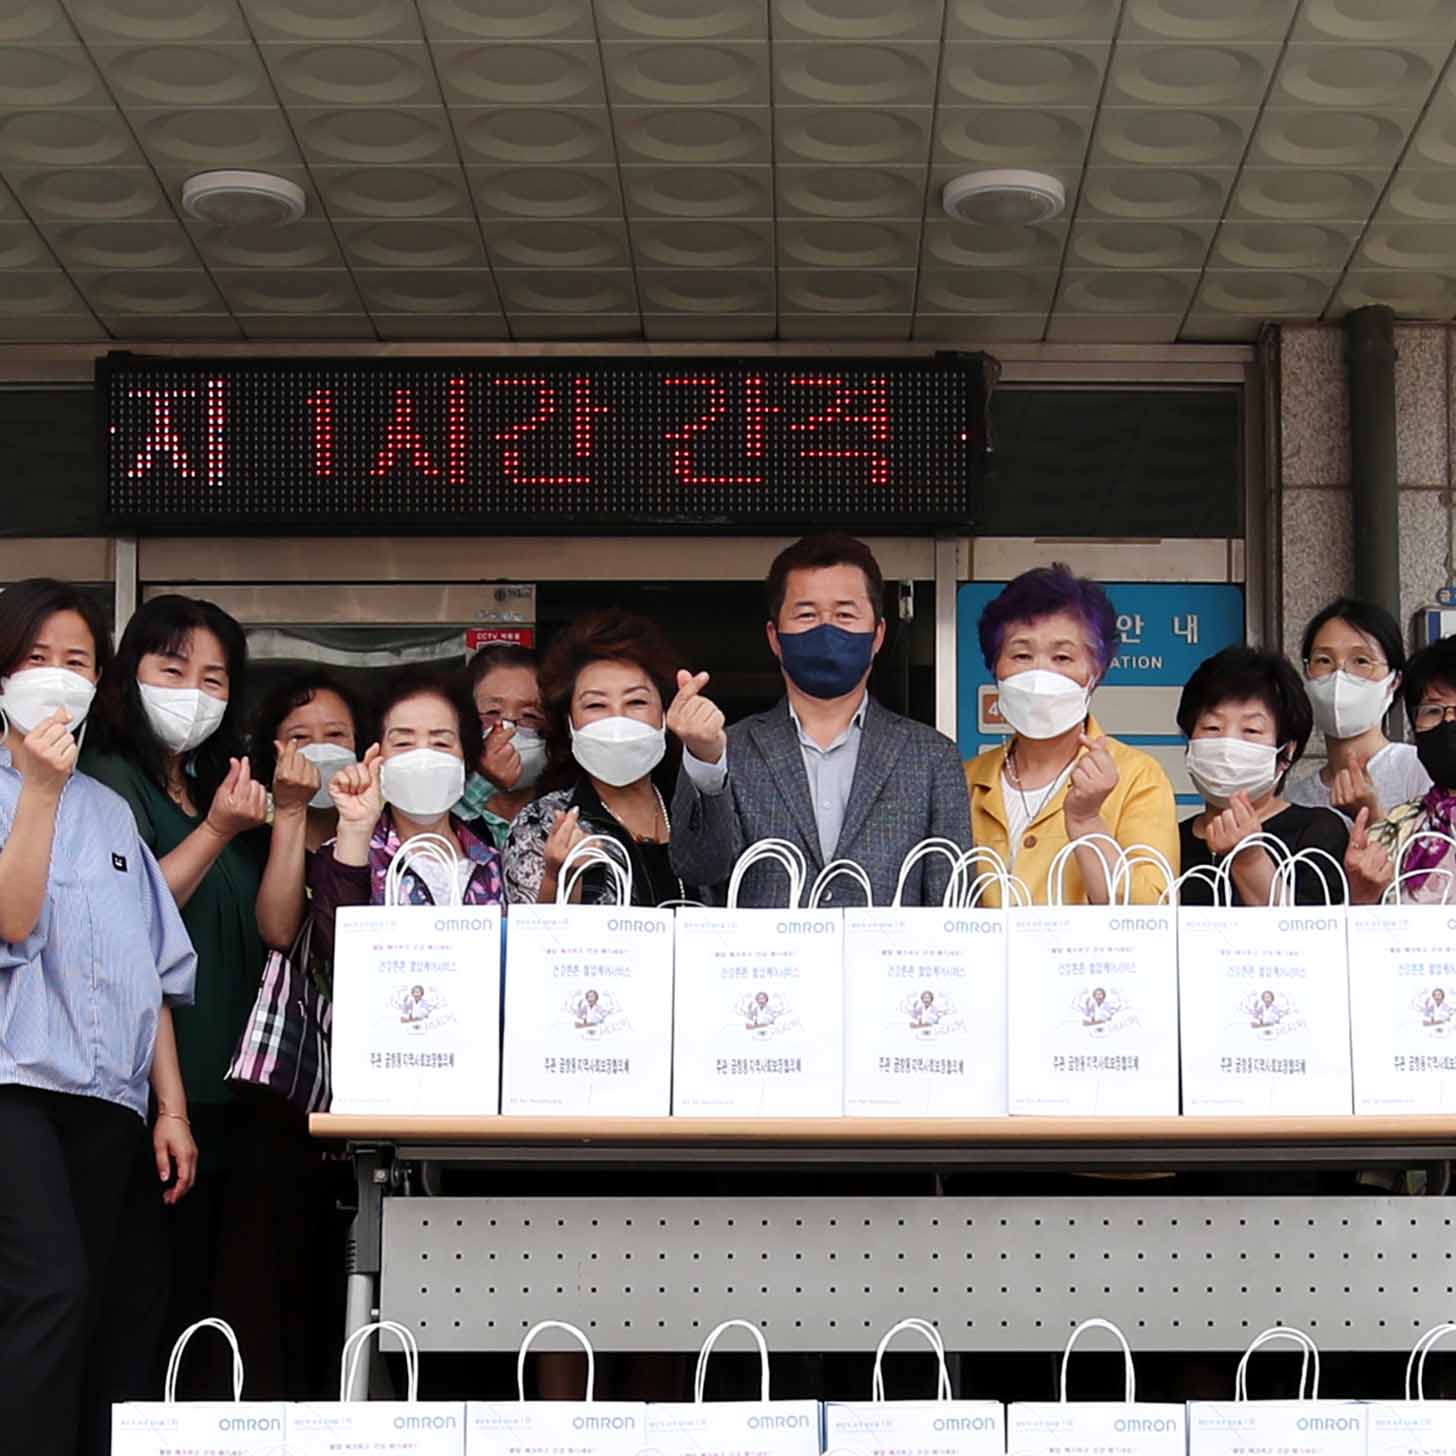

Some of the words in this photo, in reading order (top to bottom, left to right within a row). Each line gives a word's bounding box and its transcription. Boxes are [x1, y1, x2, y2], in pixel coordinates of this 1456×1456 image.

[663, 378, 891, 486] 간격
[434, 918, 492, 931] OMRON
[607, 919, 666, 933] OMRON
[776, 921, 835, 934] OMRON
[944, 920, 1002, 933] OMRON
[1109, 918, 1168, 931] OMRON
[1278, 919, 1338, 932] OMRON
[219, 1418, 280, 1431] OMRON
[393, 1416, 456, 1429] OMRON
[572, 1417, 635, 1430] OMRON
[747, 1415, 809, 1429] OMRON
[933, 1417, 995, 1431] OMRON
[1114, 1419, 1176, 1432] OMRON
[1296, 1418, 1359, 1431] OMRON
